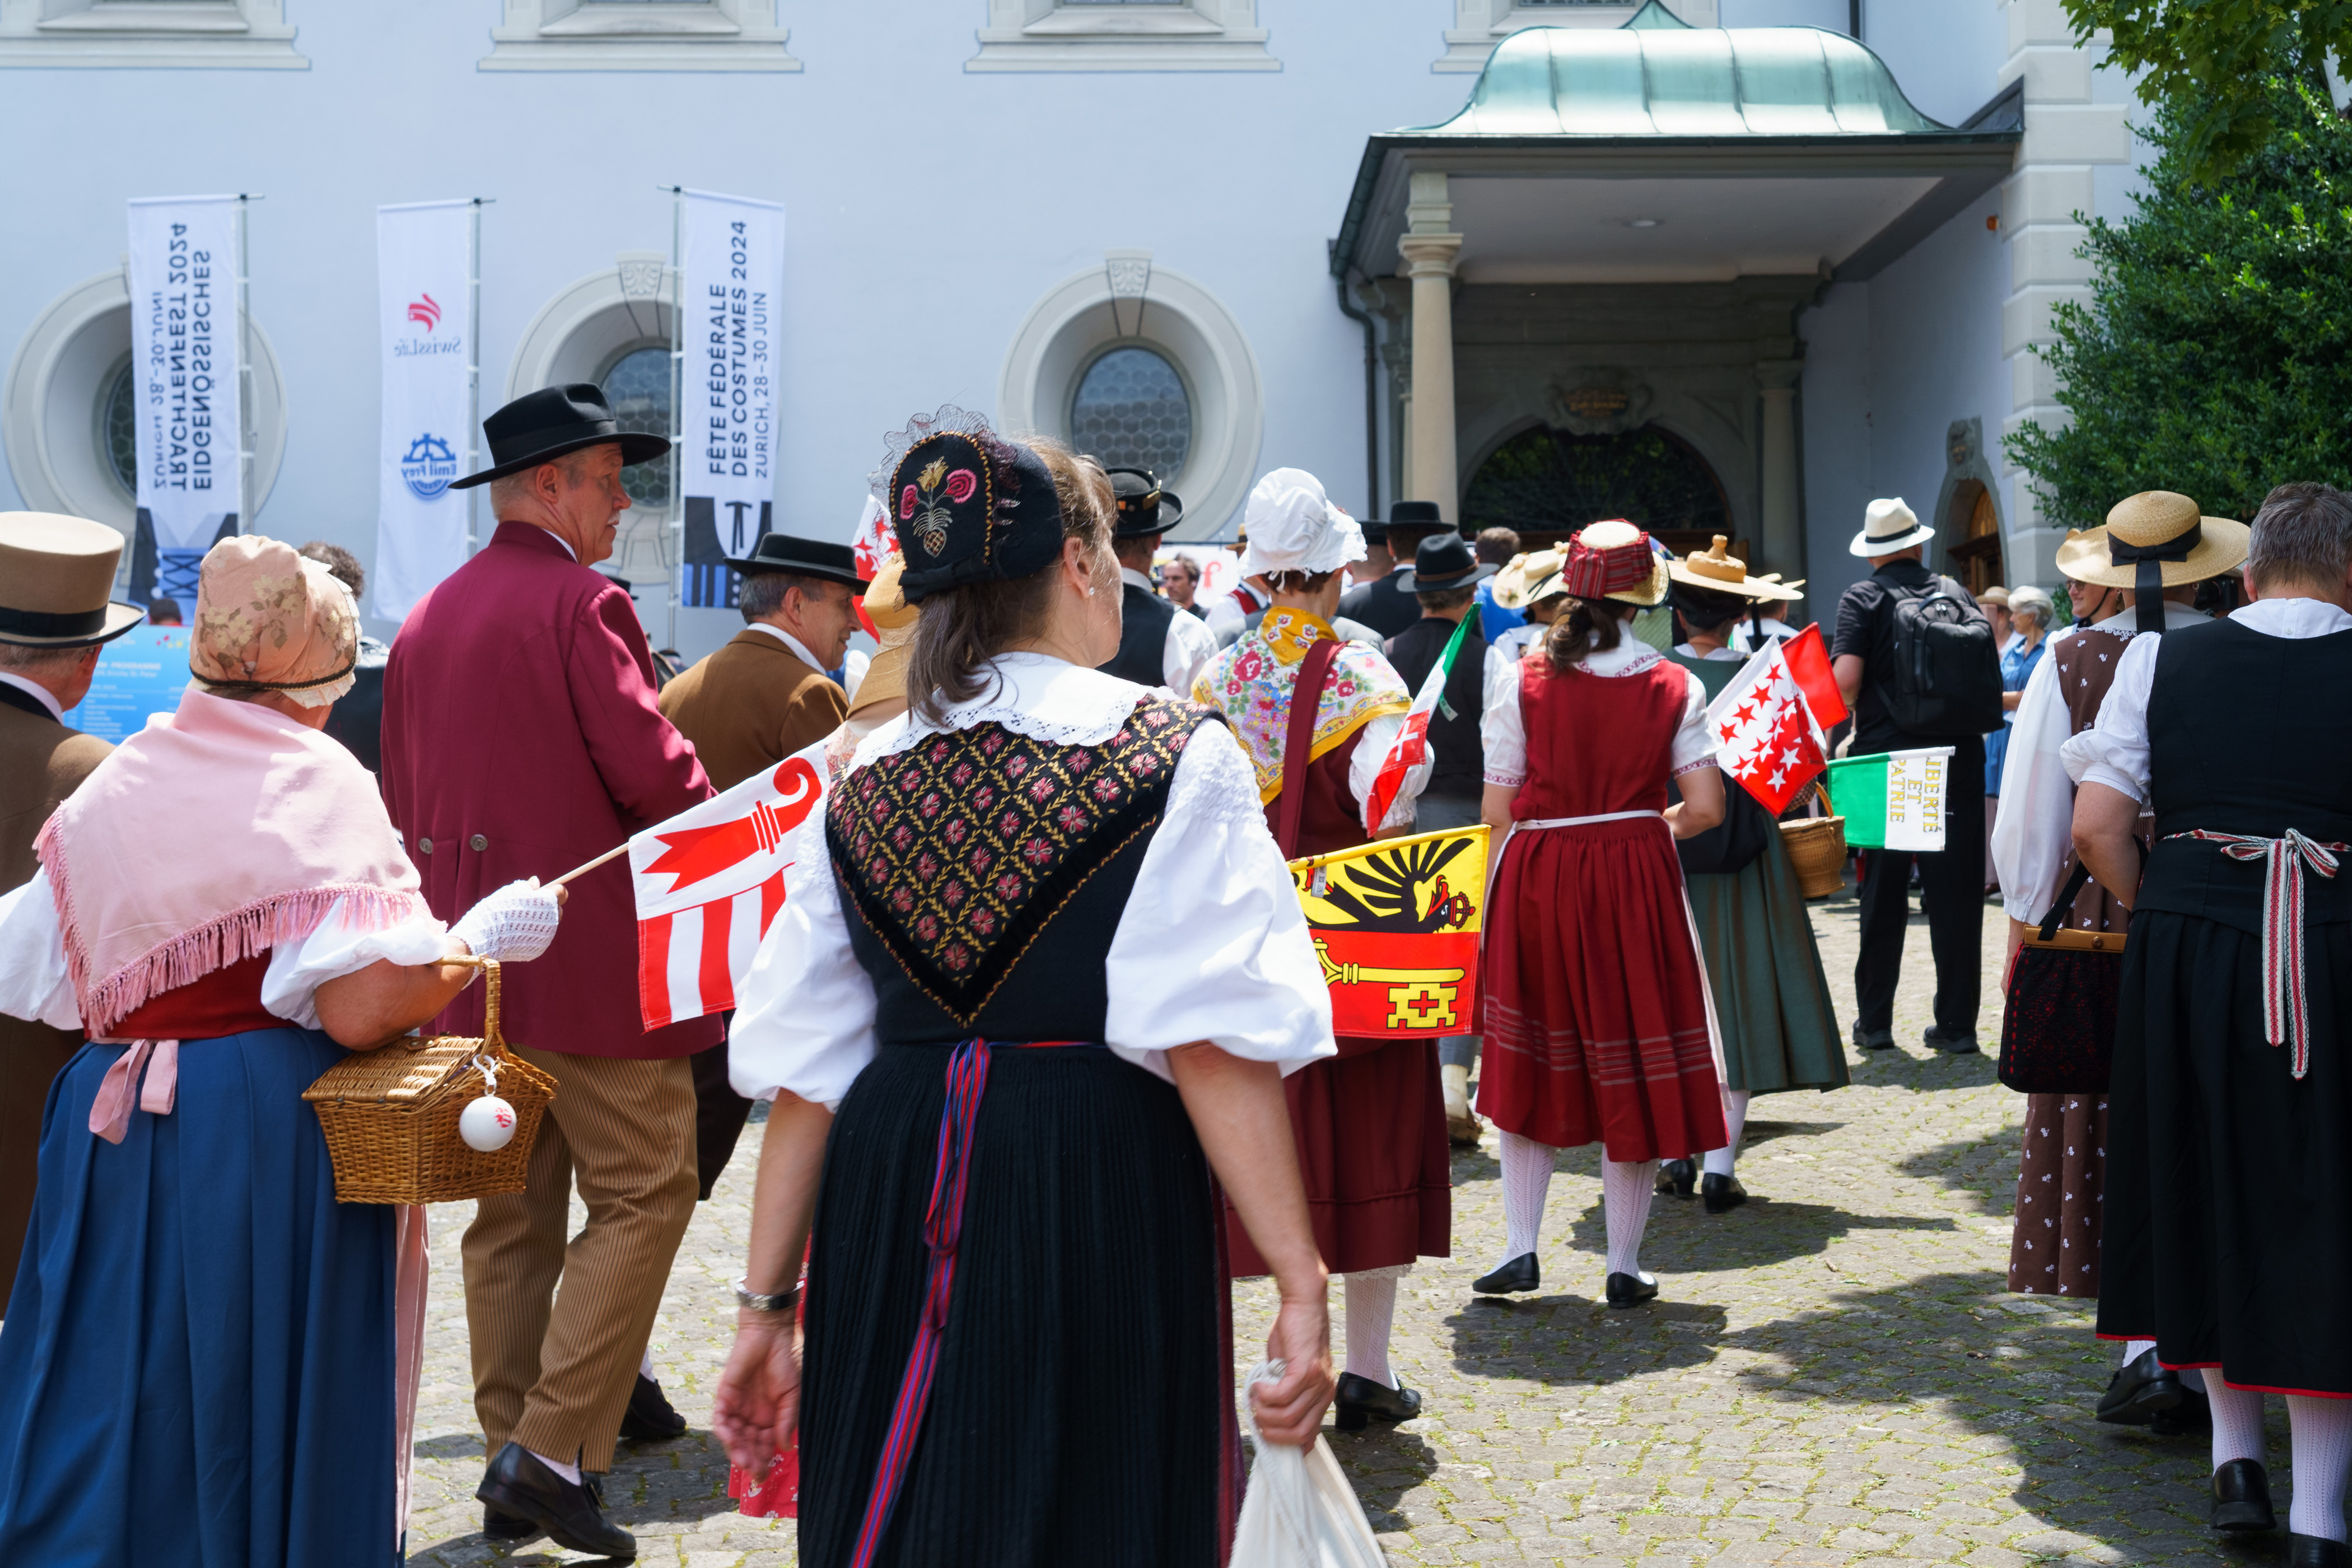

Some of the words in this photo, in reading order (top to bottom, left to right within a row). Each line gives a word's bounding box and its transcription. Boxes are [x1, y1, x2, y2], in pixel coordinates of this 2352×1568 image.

[731, 221, 746, 280] 2024
[753, 292, 767, 336] JUIN
[707, 284, 726, 408] FÉDÉRALE
[731, 287, 746, 424] COSTUMES
[706, 416, 726, 475] FÊTE
[731, 431, 747, 476] DES
[754, 402, 770, 479] ZURICH,
[1907, 778, 1922, 804] ET
[1923, 756, 1942, 833] IBERTÉ
